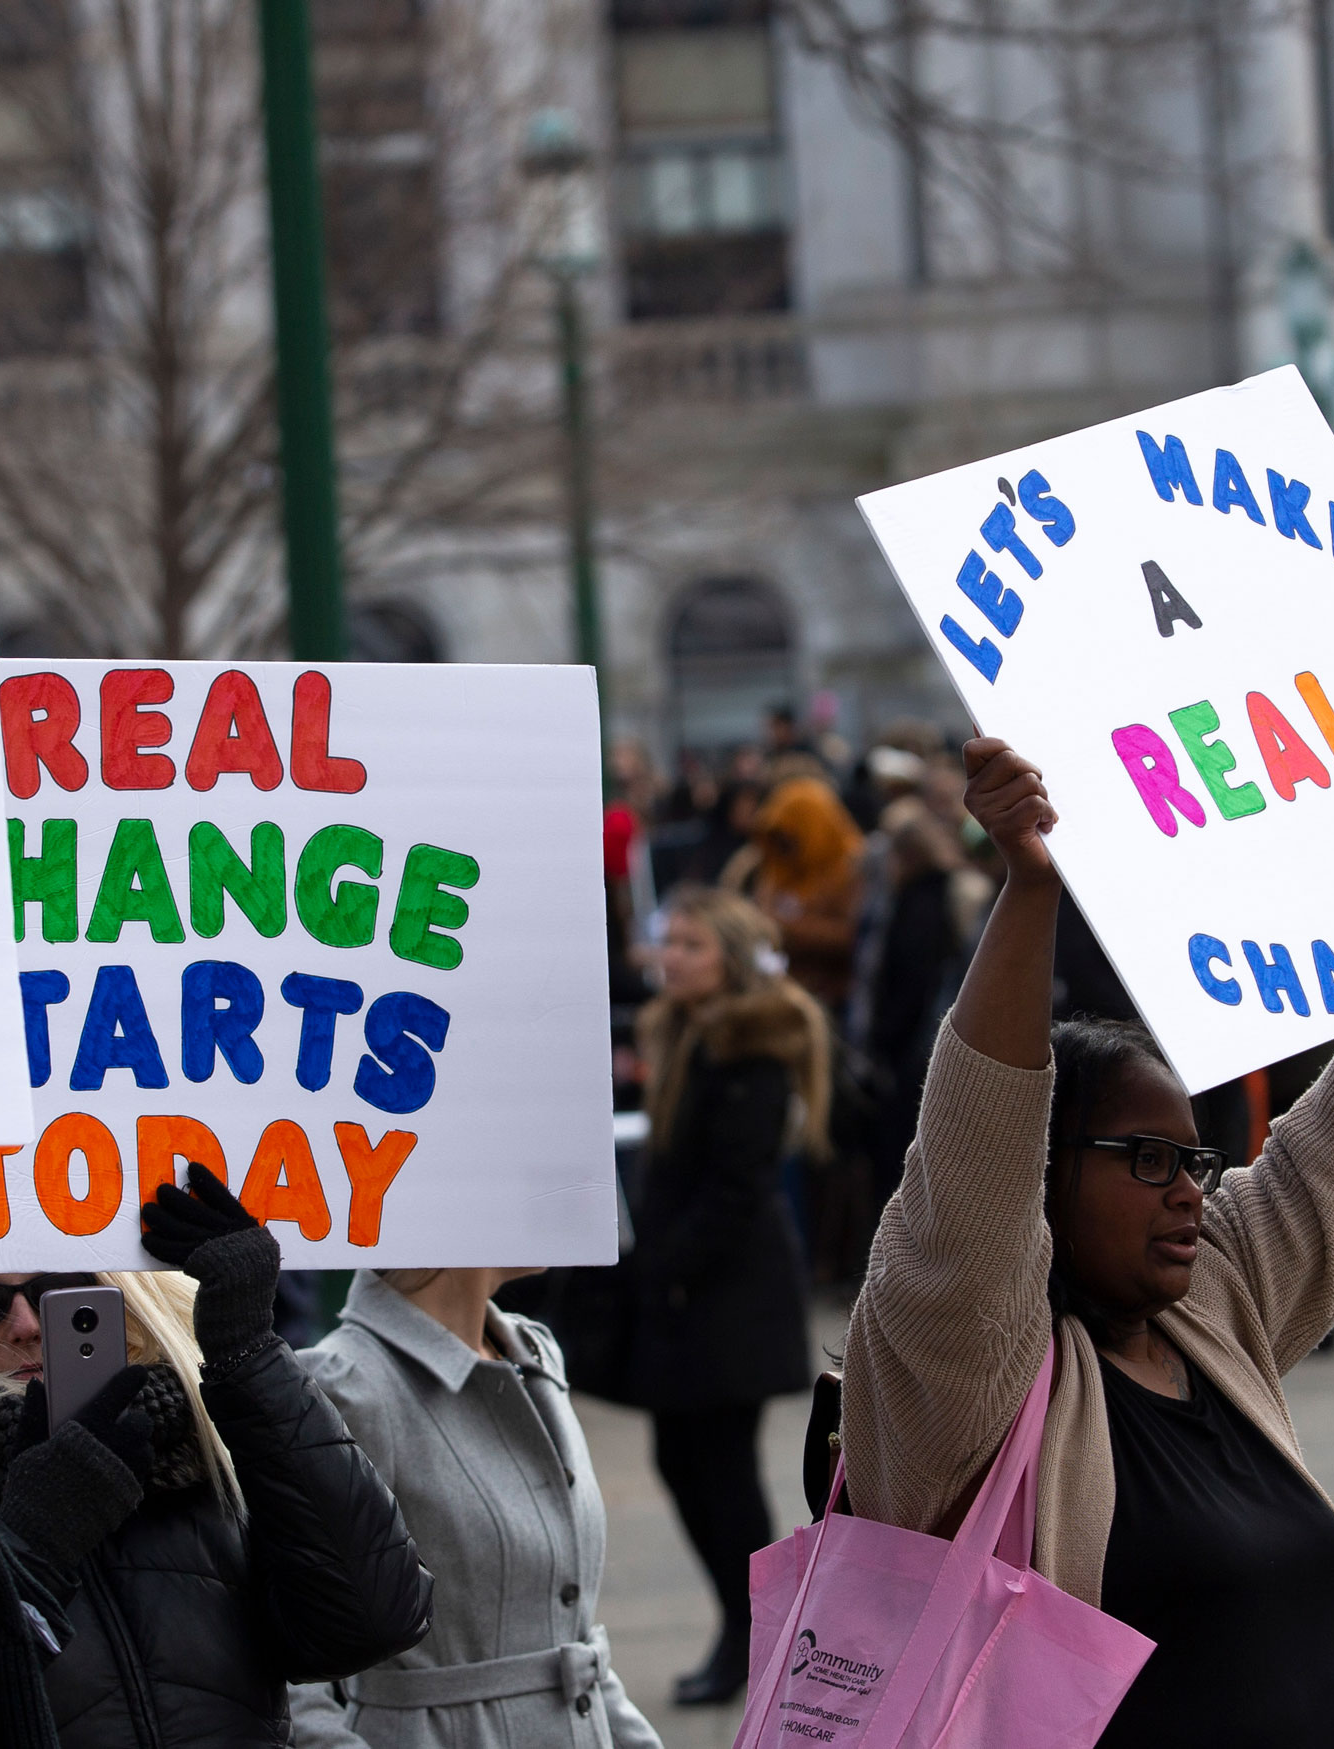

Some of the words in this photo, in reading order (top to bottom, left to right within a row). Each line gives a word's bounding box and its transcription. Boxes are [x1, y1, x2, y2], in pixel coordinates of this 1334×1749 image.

[939, 468, 1077, 686] LET'S
[1141, 559, 1203, 638] A
[6, 818, 481, 971] HANGE
[18, 960, 451, 1114] TARTS
[829, 1670, 852, 1684] HEALTH
[851, 1677, 867, 1687] CARE
